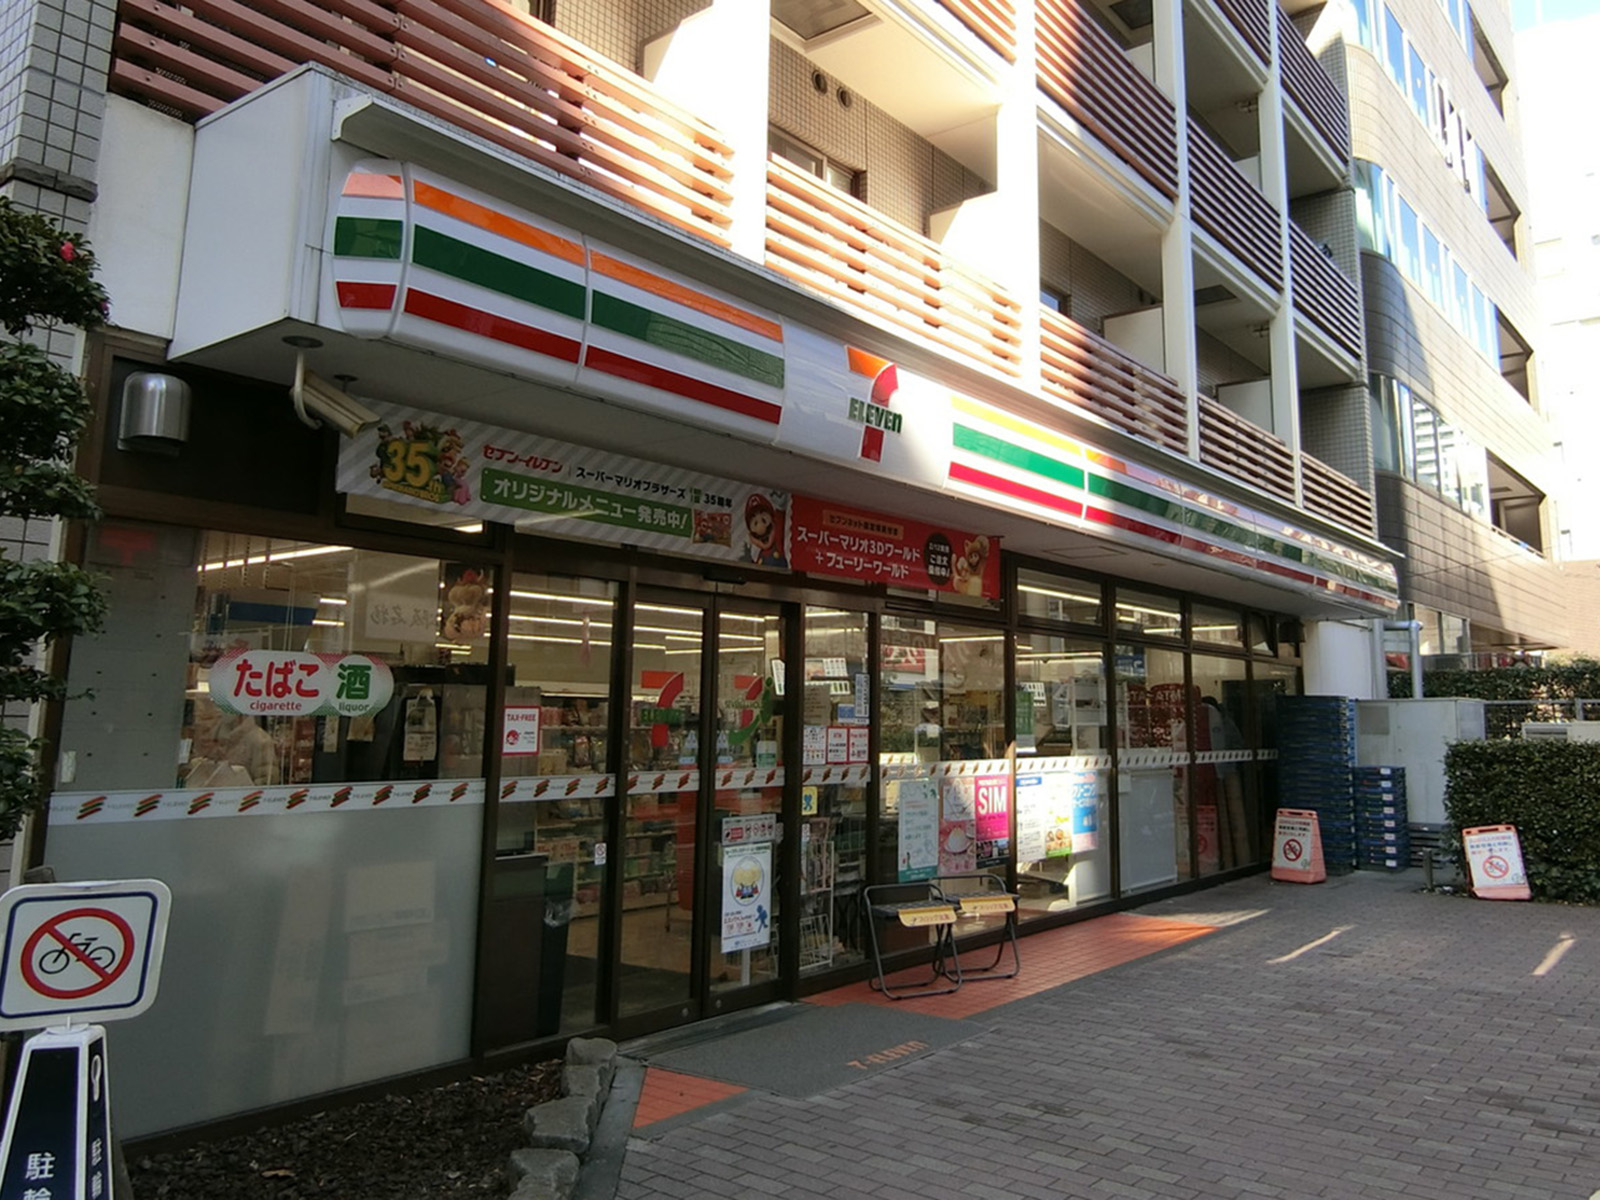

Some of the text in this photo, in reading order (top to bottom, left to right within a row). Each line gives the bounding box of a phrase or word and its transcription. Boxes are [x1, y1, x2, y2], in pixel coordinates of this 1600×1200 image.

[576, 467, 686, 499] スーパーマリオブラザーズ
[797, 526, 921, 562] スーパーマリオ3Dワールド
[233, 659, 372, 700] たばこ 酒
[250, 700, 370, 712] cigarette liquor
[506, 714, 537, 723] TAX-FREE
[978, 786, 1007, 815] SIM
